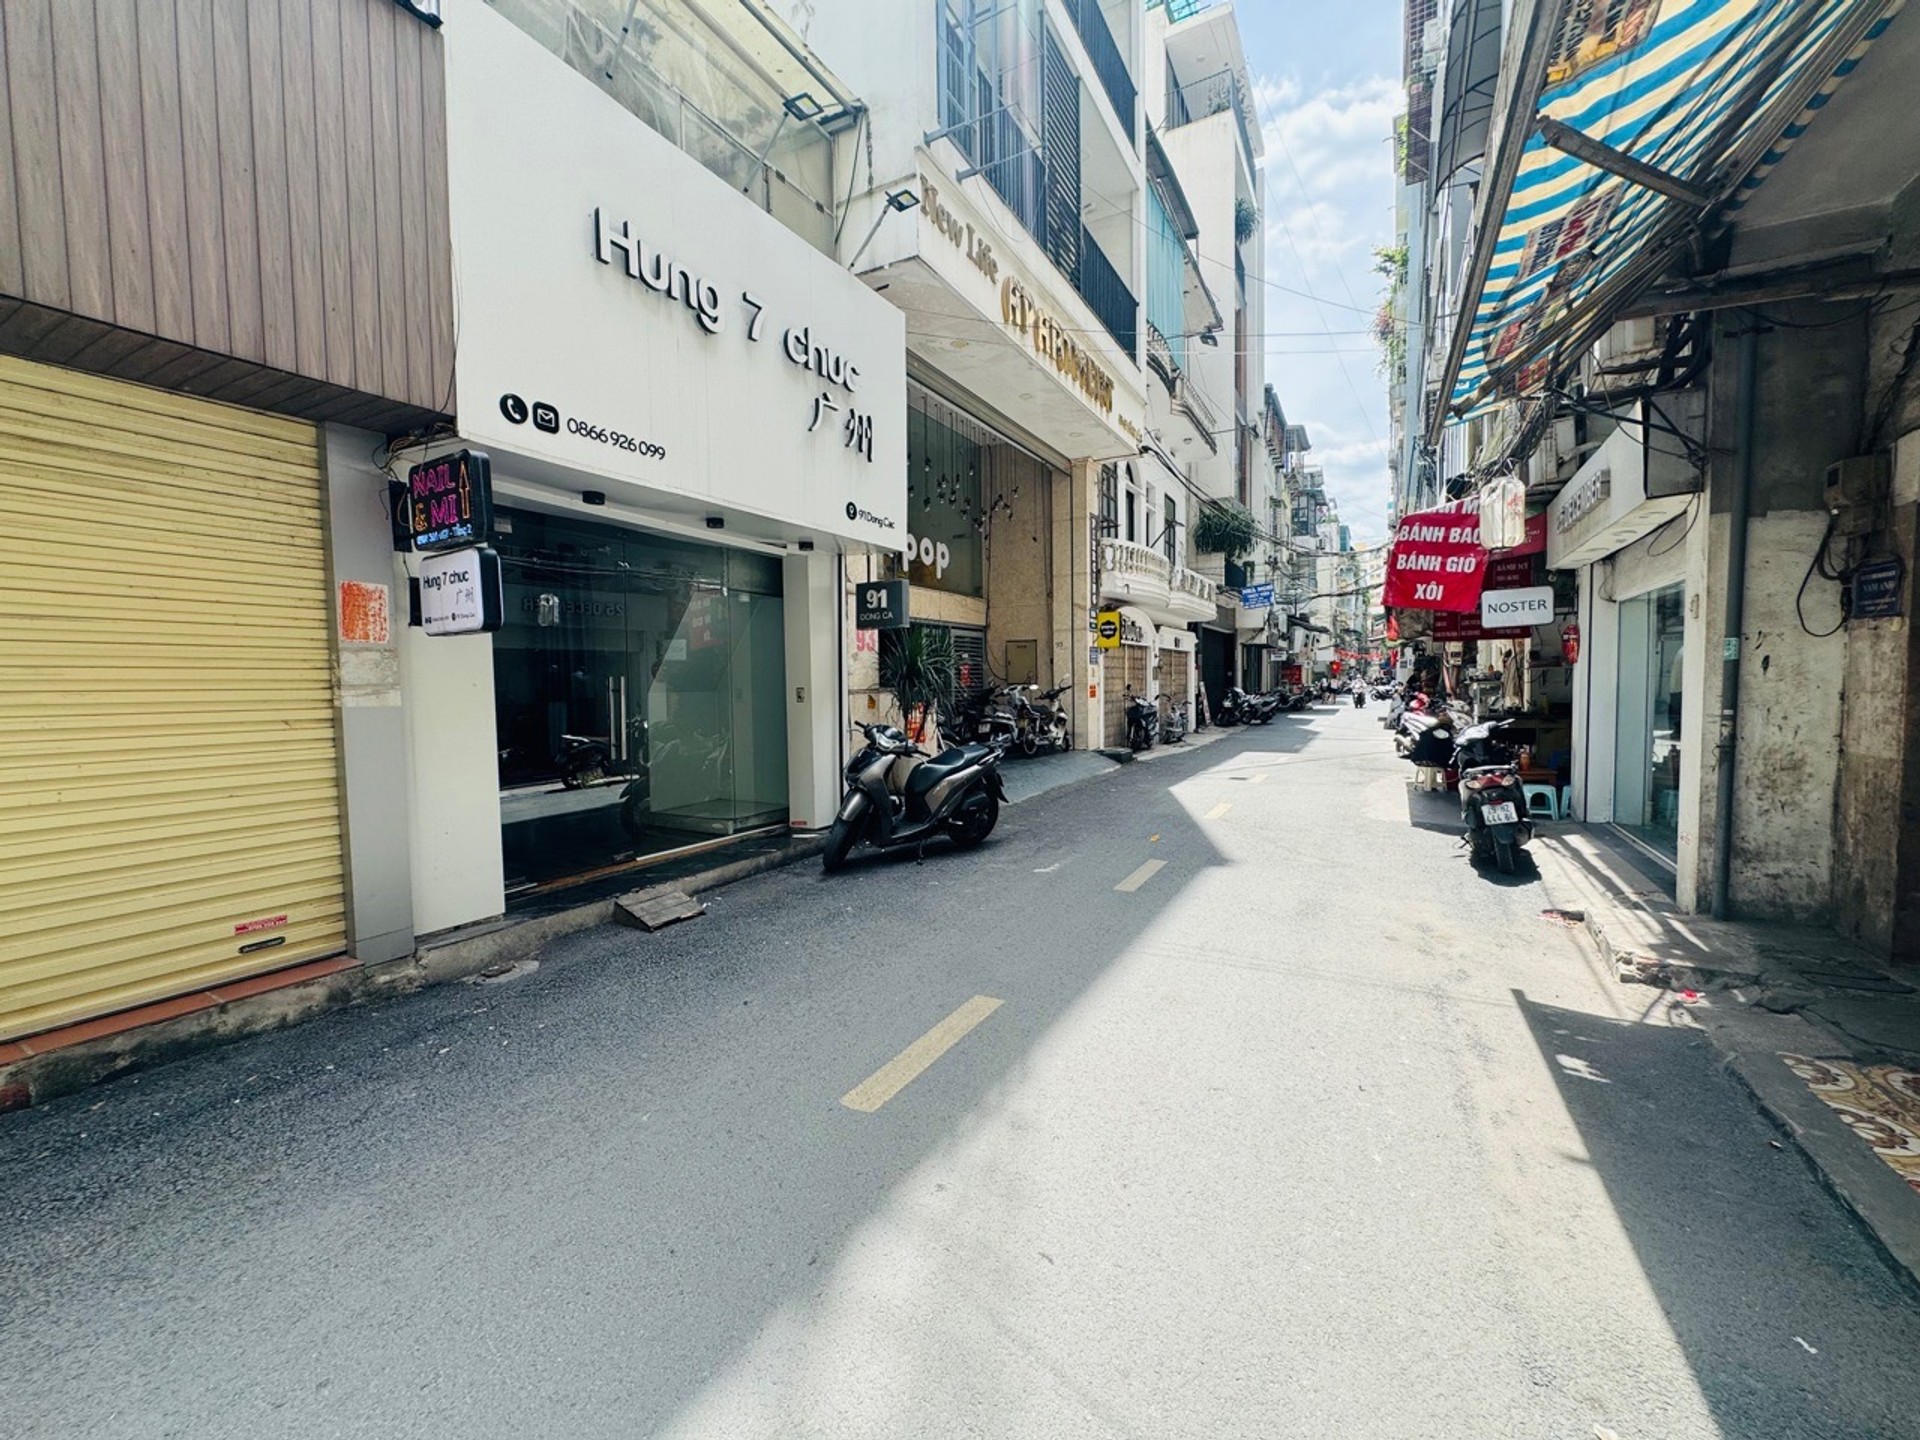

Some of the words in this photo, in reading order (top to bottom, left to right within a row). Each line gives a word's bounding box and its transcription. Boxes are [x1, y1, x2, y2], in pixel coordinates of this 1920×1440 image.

[920, 173, 964, 248] New
[966, 222, 999, 285] Life
[594, 206, 725, 334] Hung
[742, 291, 769, 342] 7
[784, 326, 861, 393] chuc
[567, 417, 609, 444] 0866
[610, 431, 637, 452] 926
[638, 440, 666, 461] 099
[808, 391, 874, 463] 广州
[413, 463, 456, 499] NAIL
[415, 503, 428, 531] &
[431, 494, 458, 527] MI
[1399, 522, 1446, 543] BÁNH
[1396, 551, 1442, 572] BÁNH
[1445, 553, 1477, 574] GIÒ
[423, 574, 441, 591] Hung
[442, 571, 447, 586] 7
[449, 569, 469, 584] chuc
[1413, 580, 1444, 601] XÔI
[866, 589, 888, 609] 91
[1488, 599, 1548, 614] NOSTER
